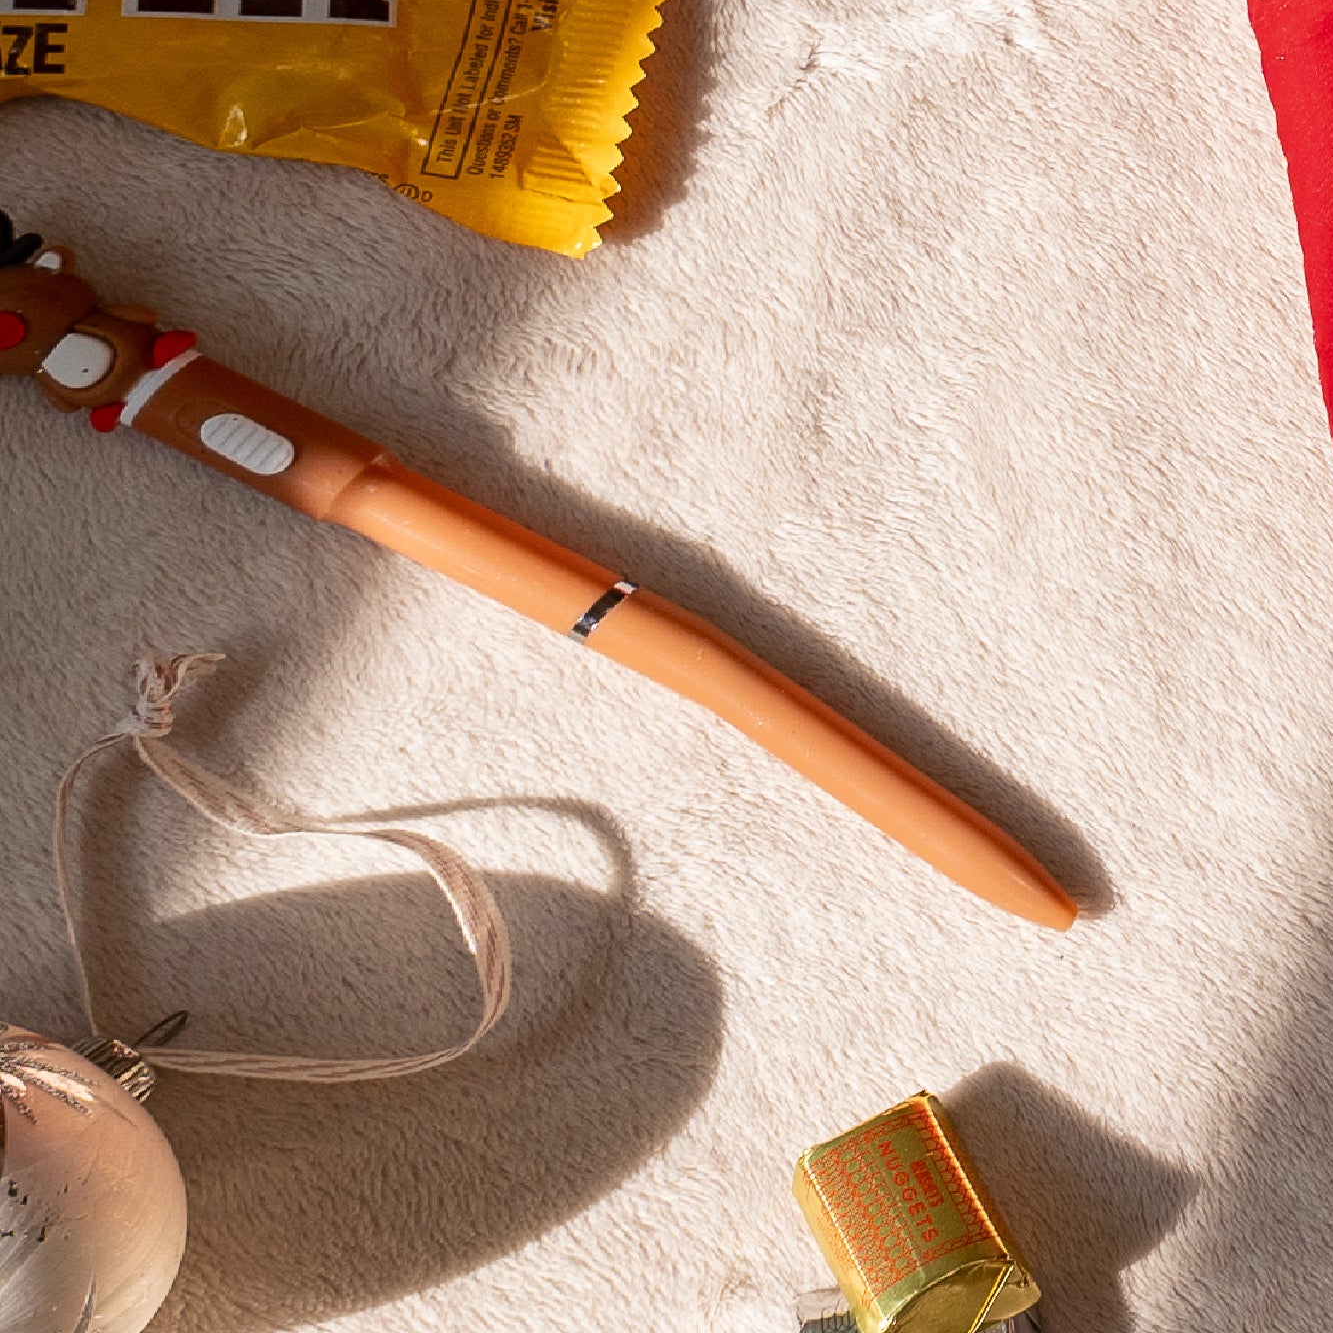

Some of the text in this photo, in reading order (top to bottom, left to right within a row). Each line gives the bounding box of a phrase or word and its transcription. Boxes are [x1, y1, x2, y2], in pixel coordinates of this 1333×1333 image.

[474, 19, 494, 40] for
[509, 11, 529, 36] Call
[0, 23, 68, 76] ZE
[461, 42, 489, 90] Labeled
[436, 139, 457, 163] This
[876, 1140, 939, 1242] NUGGETS
